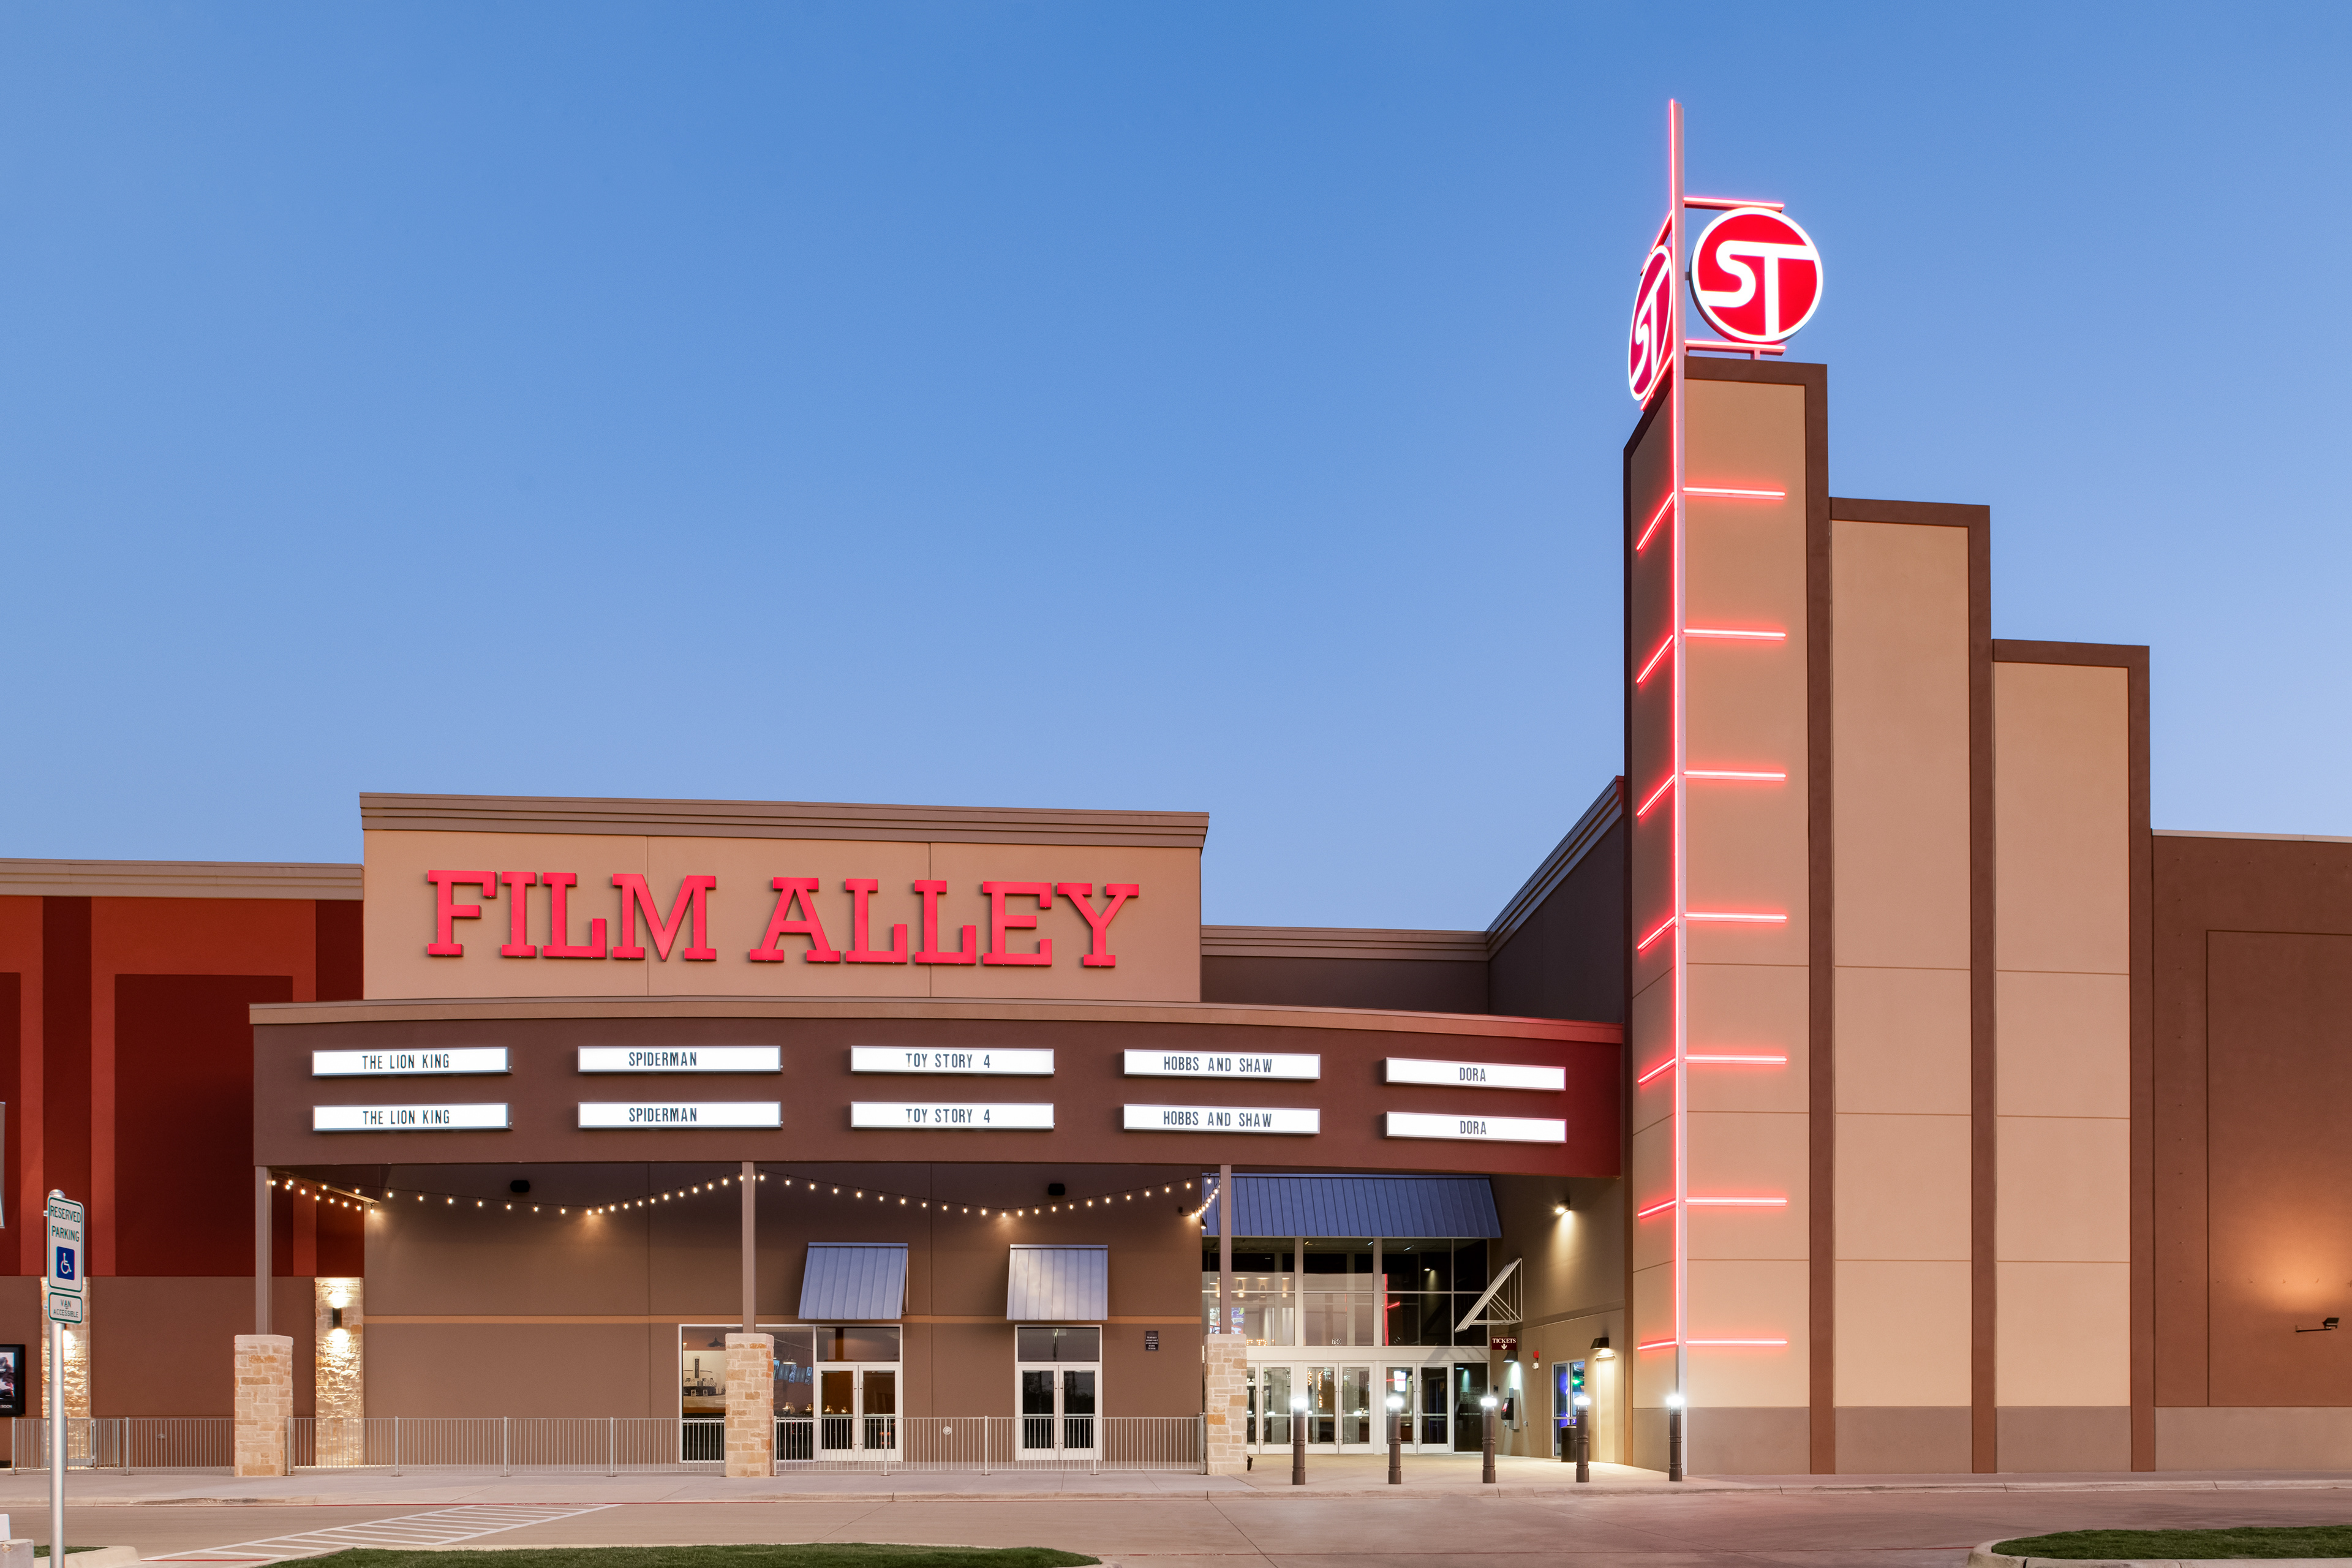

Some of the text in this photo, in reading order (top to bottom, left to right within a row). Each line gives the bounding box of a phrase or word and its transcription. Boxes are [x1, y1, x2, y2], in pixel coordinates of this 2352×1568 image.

[1697, 238, 1818, 338] ST
[1629, 254, 1670, 393] ST
[427, 869, 1140, 968] FILM ALLEY
[362, 1054, 450, 1069] THE LION KING
[628, 1052, 698, 1066] SPIDERMAN
[905, 1053, 990, 1068] TOY STORY 4
[1164, 1056, 1272, 1072] HOBBS AND SHAW
[1460, 1067, 1487, 1082] DORA
[362, 1109, 450, 1125] THE LION KING
[628, 1107, 698, 1122] SPIDERMAN
[905, 1108, 990, 1123] TOY STORY 4
[1163, 1110, 1272, 1127] HOBBS AND SHAW
[1460, 1120, 1487, 1134] DORA
[50, 1205, 81, 1223] RESERVED
[51, 1225, 80, 1242] PARKING
[60, 1299, 72, 1308] VAN
[53, 1308, 78, 1318] ACCESSIBLE
